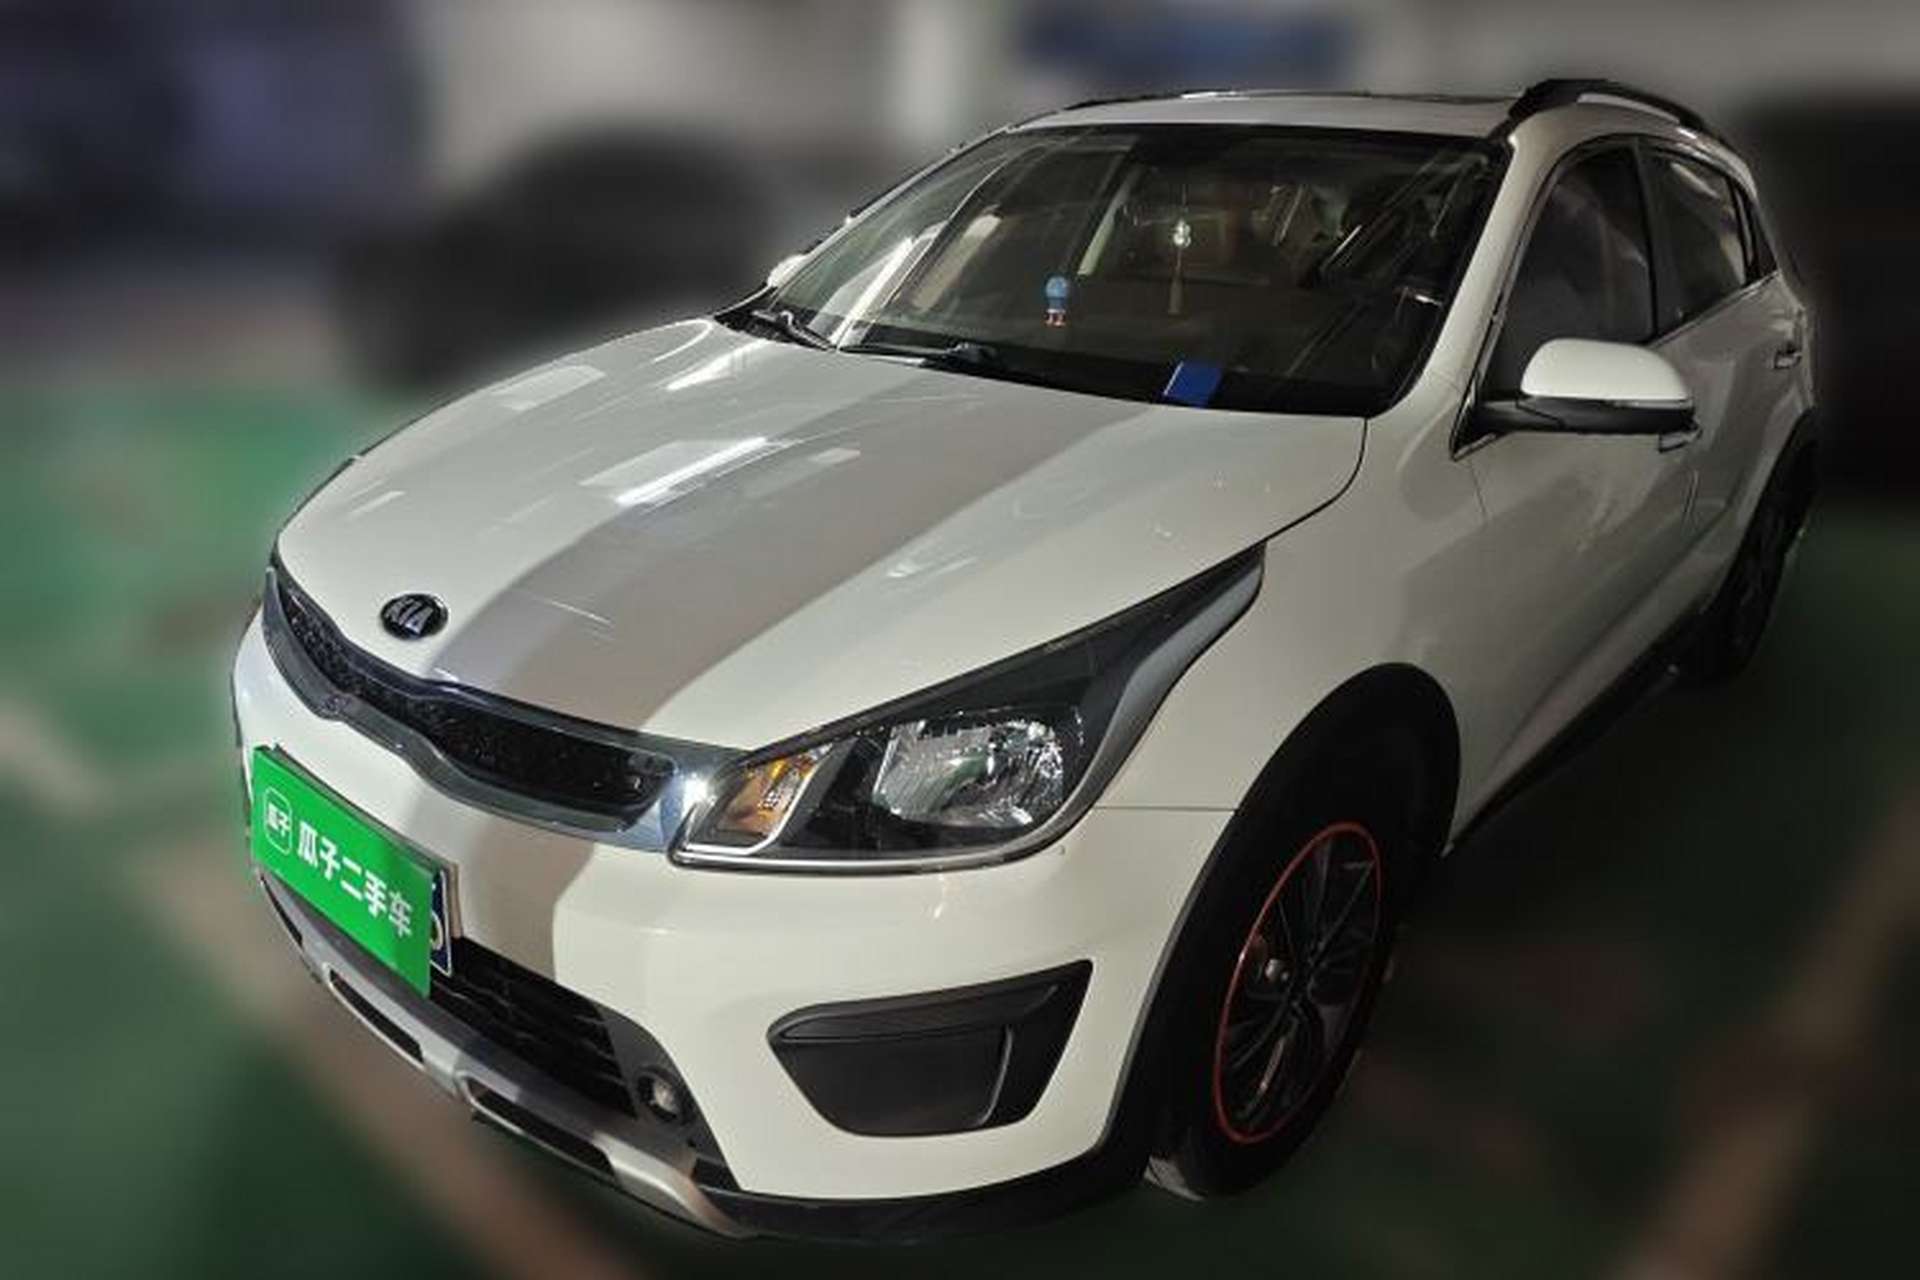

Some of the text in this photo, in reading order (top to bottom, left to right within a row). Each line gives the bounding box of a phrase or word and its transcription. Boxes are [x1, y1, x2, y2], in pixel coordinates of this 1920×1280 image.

[298, 822, 412, 937] 瓜子二手车
